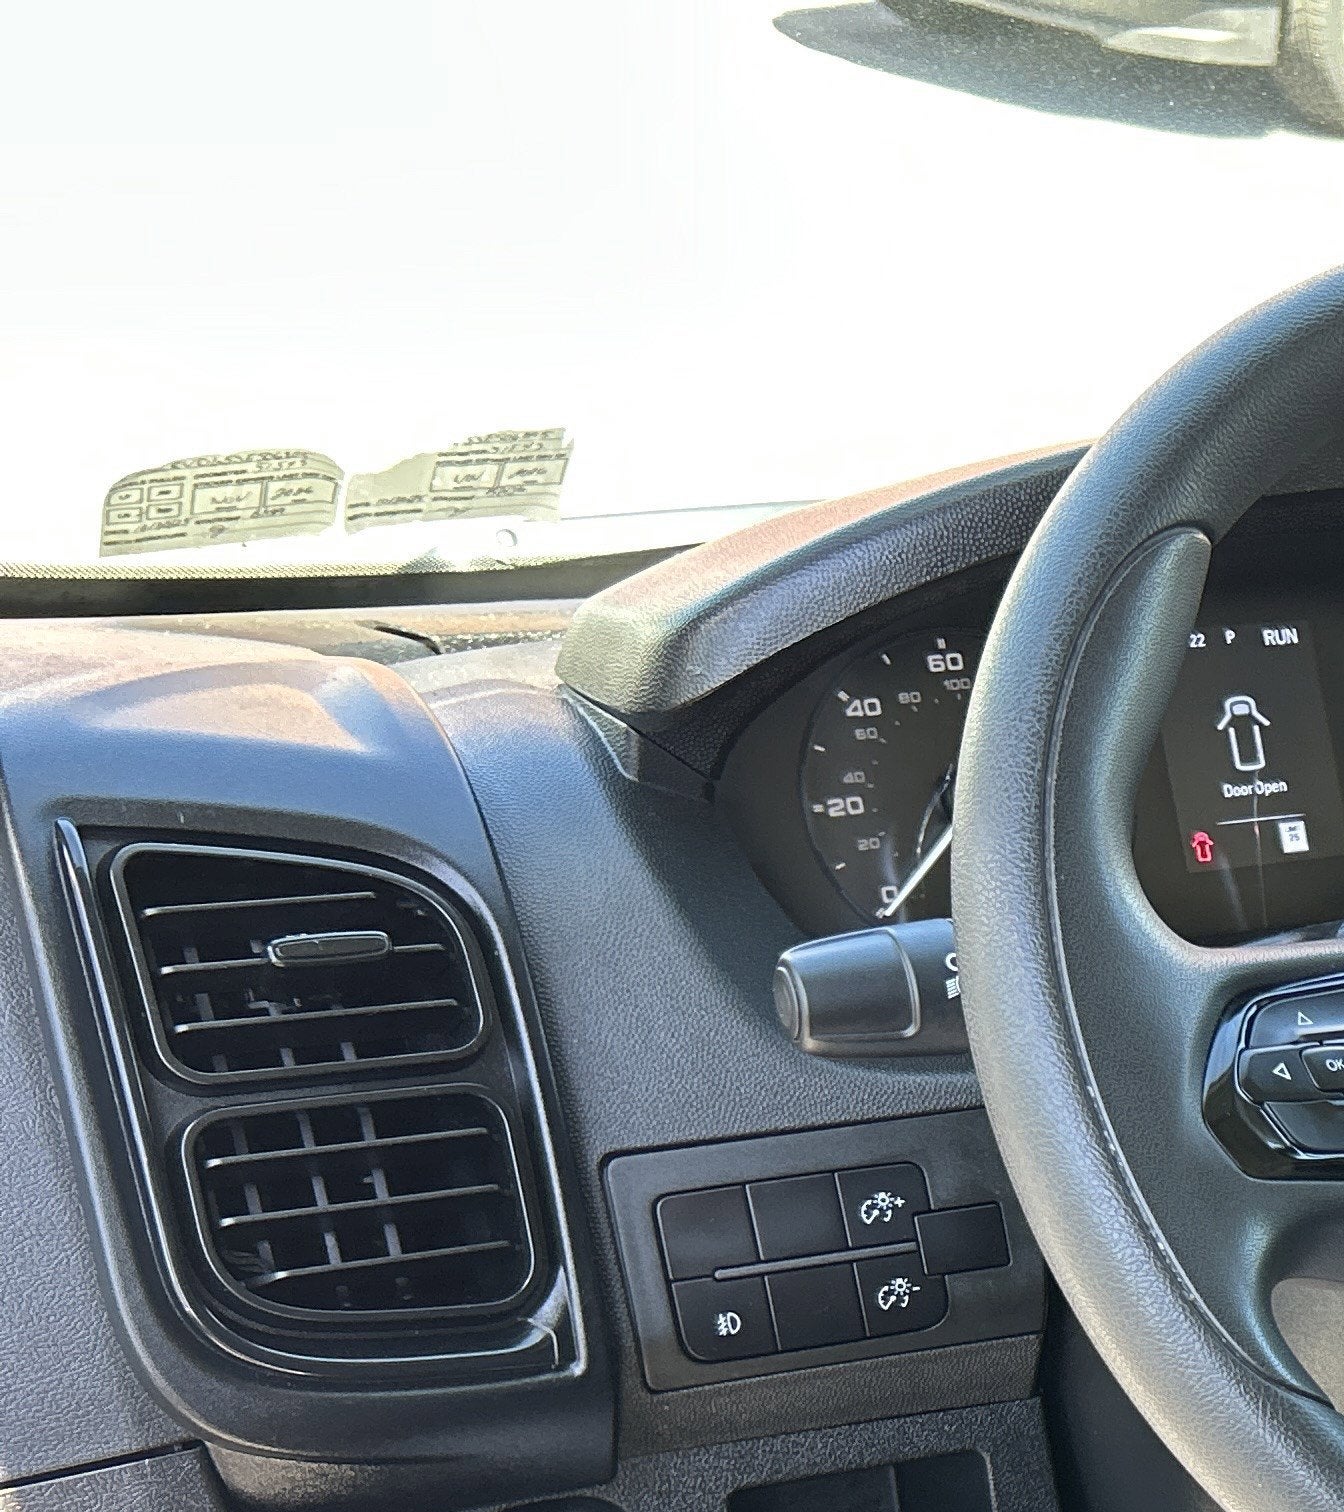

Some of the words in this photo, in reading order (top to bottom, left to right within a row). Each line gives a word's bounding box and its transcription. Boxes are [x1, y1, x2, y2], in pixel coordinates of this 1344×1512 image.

[1225, 630, 1236, 645] P
[1262, 628, 1299, 646] RUN
[927, 652, 964, 672] 60
[943, 678, 971, 690] 100
[898, 691, 921, 704] 80
[845, 698, 882, 717] 40
[843, 771, 866, 784] 40
[1222, 783, 1253, 799] Door
[1255, 781, 1288, 797] Open
[828, 796, 864, 817] 20
[857, 838, 880, 851] 20
[881, 886, 898, 903] 0
